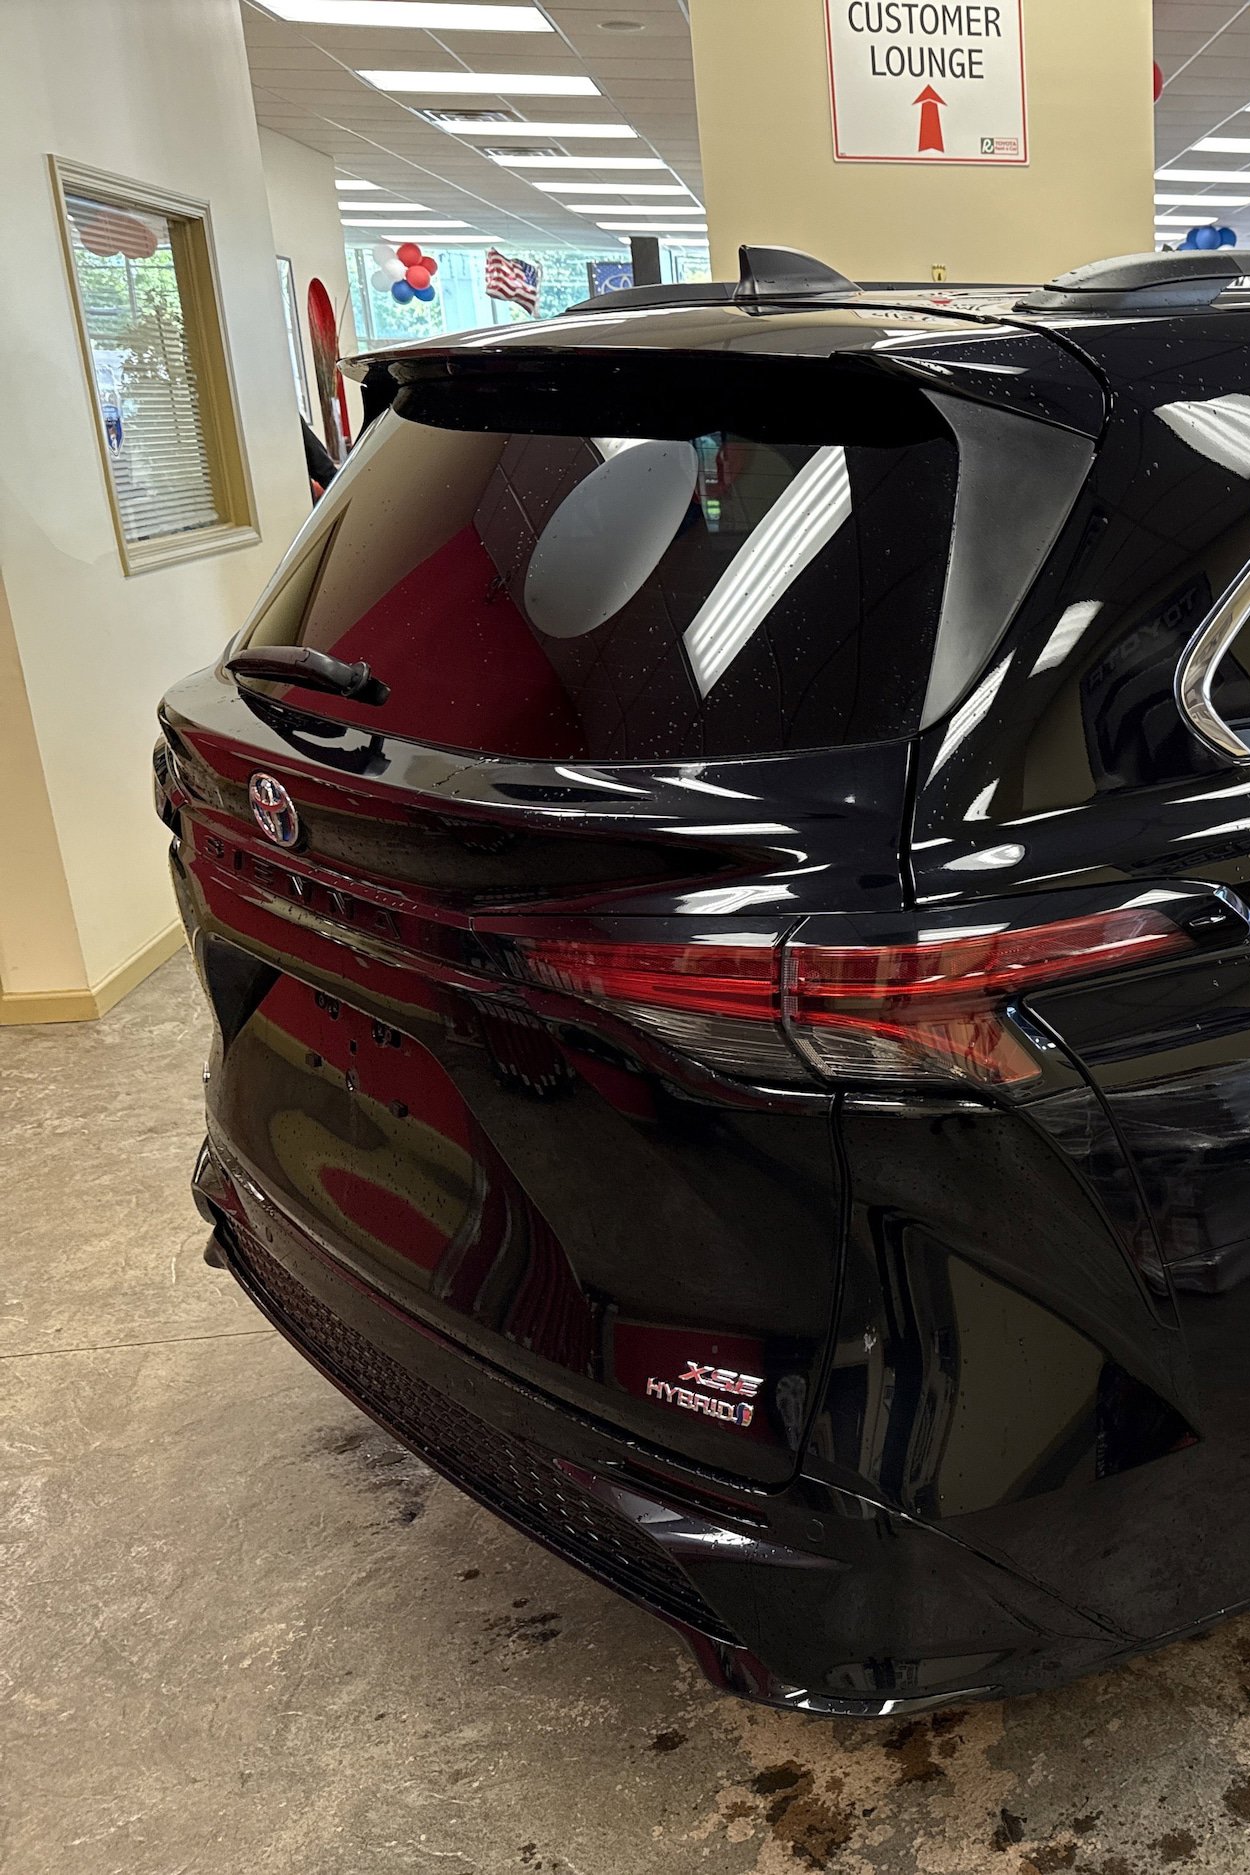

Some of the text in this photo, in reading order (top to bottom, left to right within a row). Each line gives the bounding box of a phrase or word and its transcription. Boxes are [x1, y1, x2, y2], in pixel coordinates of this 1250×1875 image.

[848, 1, 1002, 37] CUSTOMER
[870, 45, 985, 79] LOUNGE
[202, 833, 401, 940] SIENNA
[678, 1360, 764, 1397] XSE
[646, 1376, 738, 1423] HYBRID
